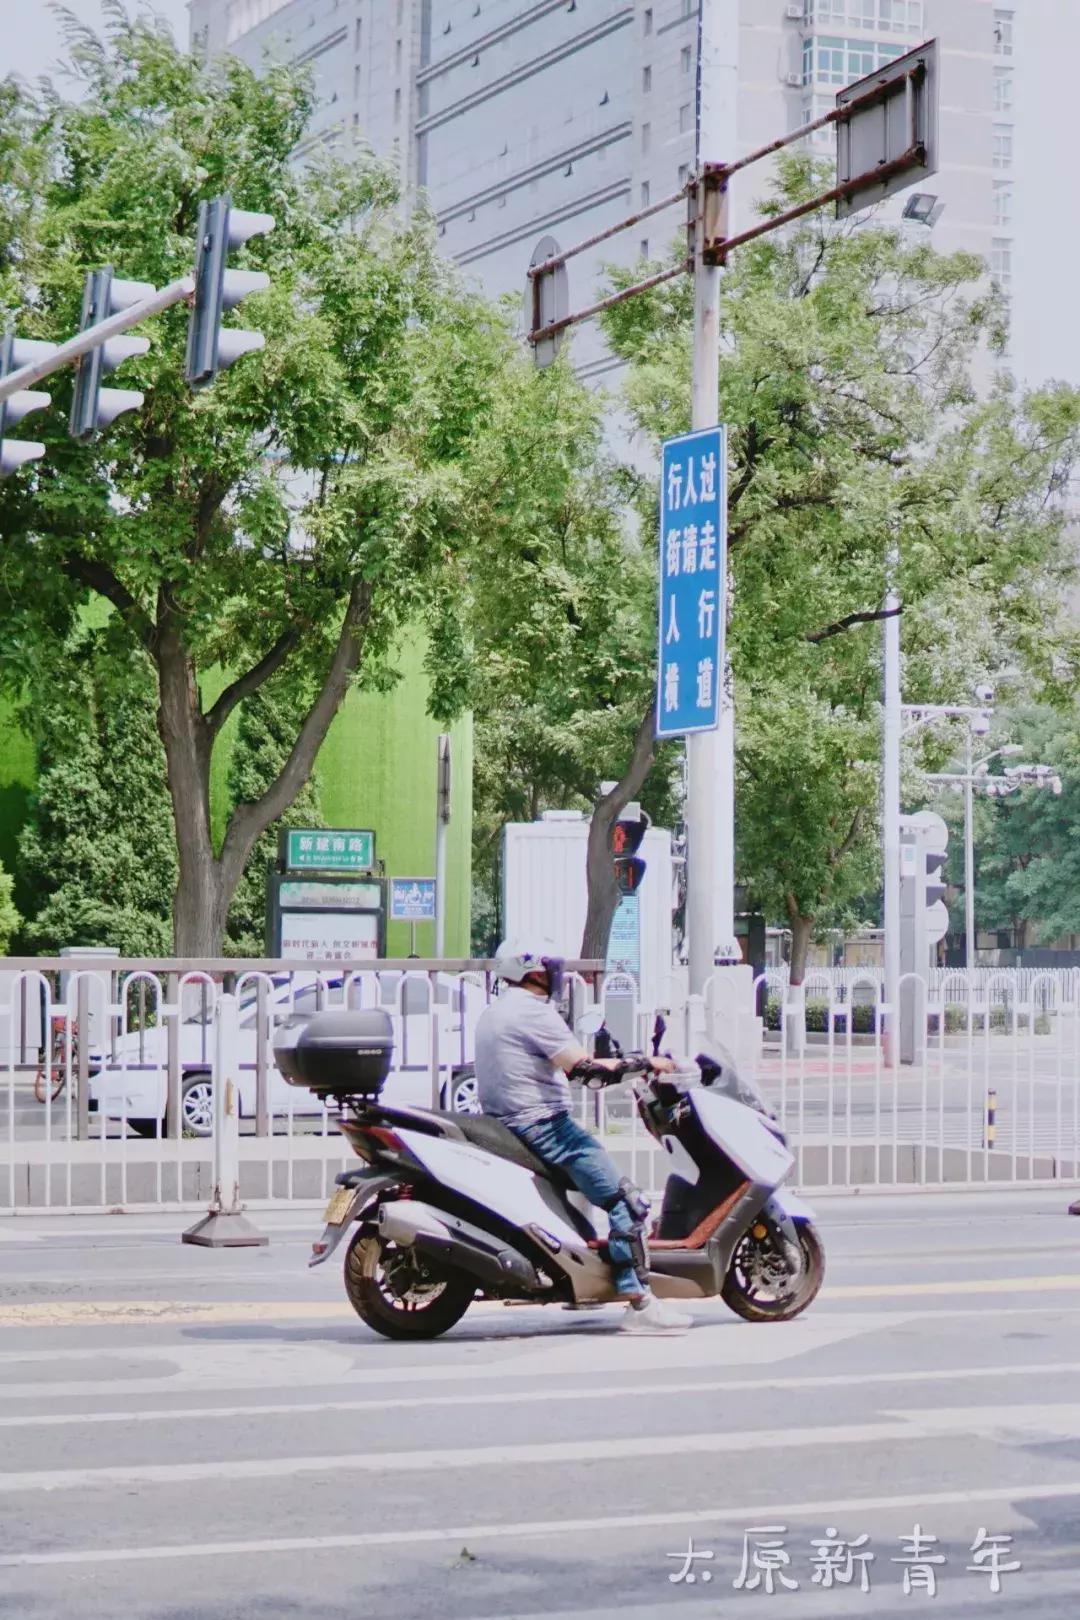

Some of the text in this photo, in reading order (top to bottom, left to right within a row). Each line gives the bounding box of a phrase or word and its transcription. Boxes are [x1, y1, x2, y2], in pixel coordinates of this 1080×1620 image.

[667, 452, 717, 511] 行人过
[666, 520, 717, 577] 街请走
[665, 588, 715, 645] 人行
[664, 656, 714, 713] 横道
[299, 836, 363, 852] 新建南路
